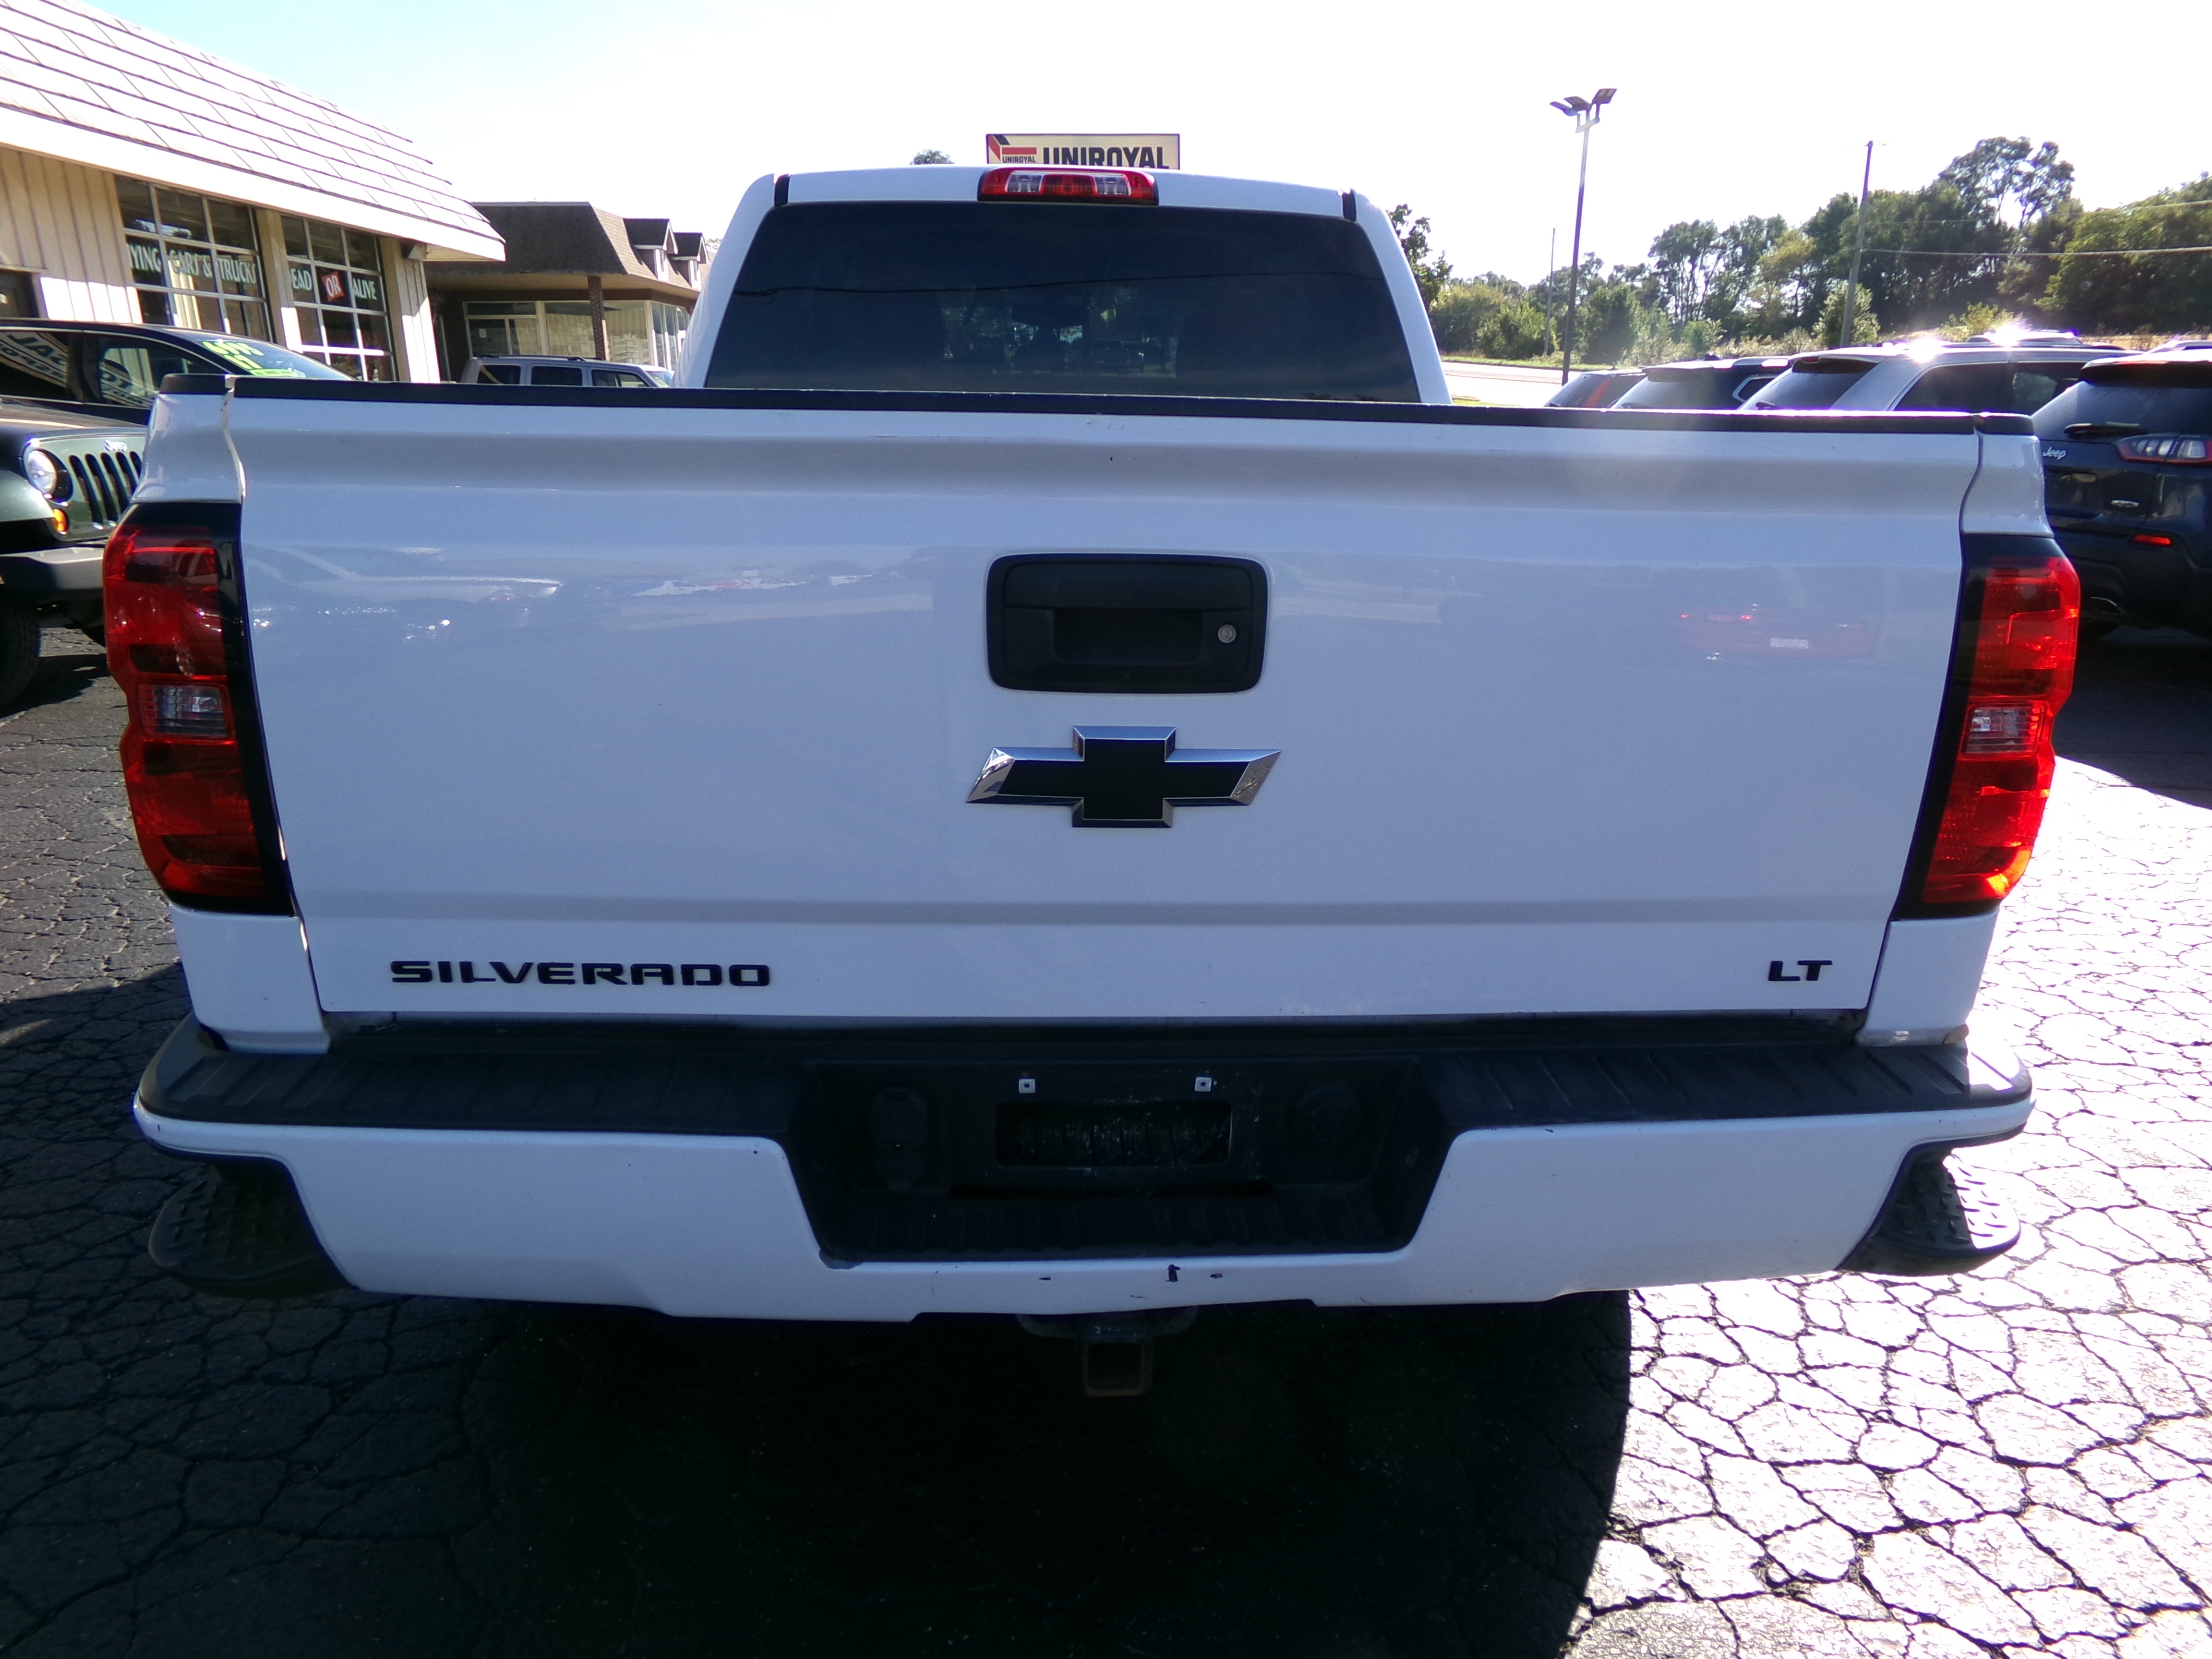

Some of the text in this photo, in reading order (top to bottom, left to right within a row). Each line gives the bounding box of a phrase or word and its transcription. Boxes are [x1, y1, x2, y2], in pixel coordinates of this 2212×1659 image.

[1043, 146, 1170, 169] UNIROYAL
[128, 244, 256, 284] YING CARS & TRUCKS
[290, 268, 378, 301] EAD OR ALIVE
[2043, 446, 2067, 460] Jeep
[389, 961, 770, 986] SILVERADO
[1767, 960, 1833, 981] LT
